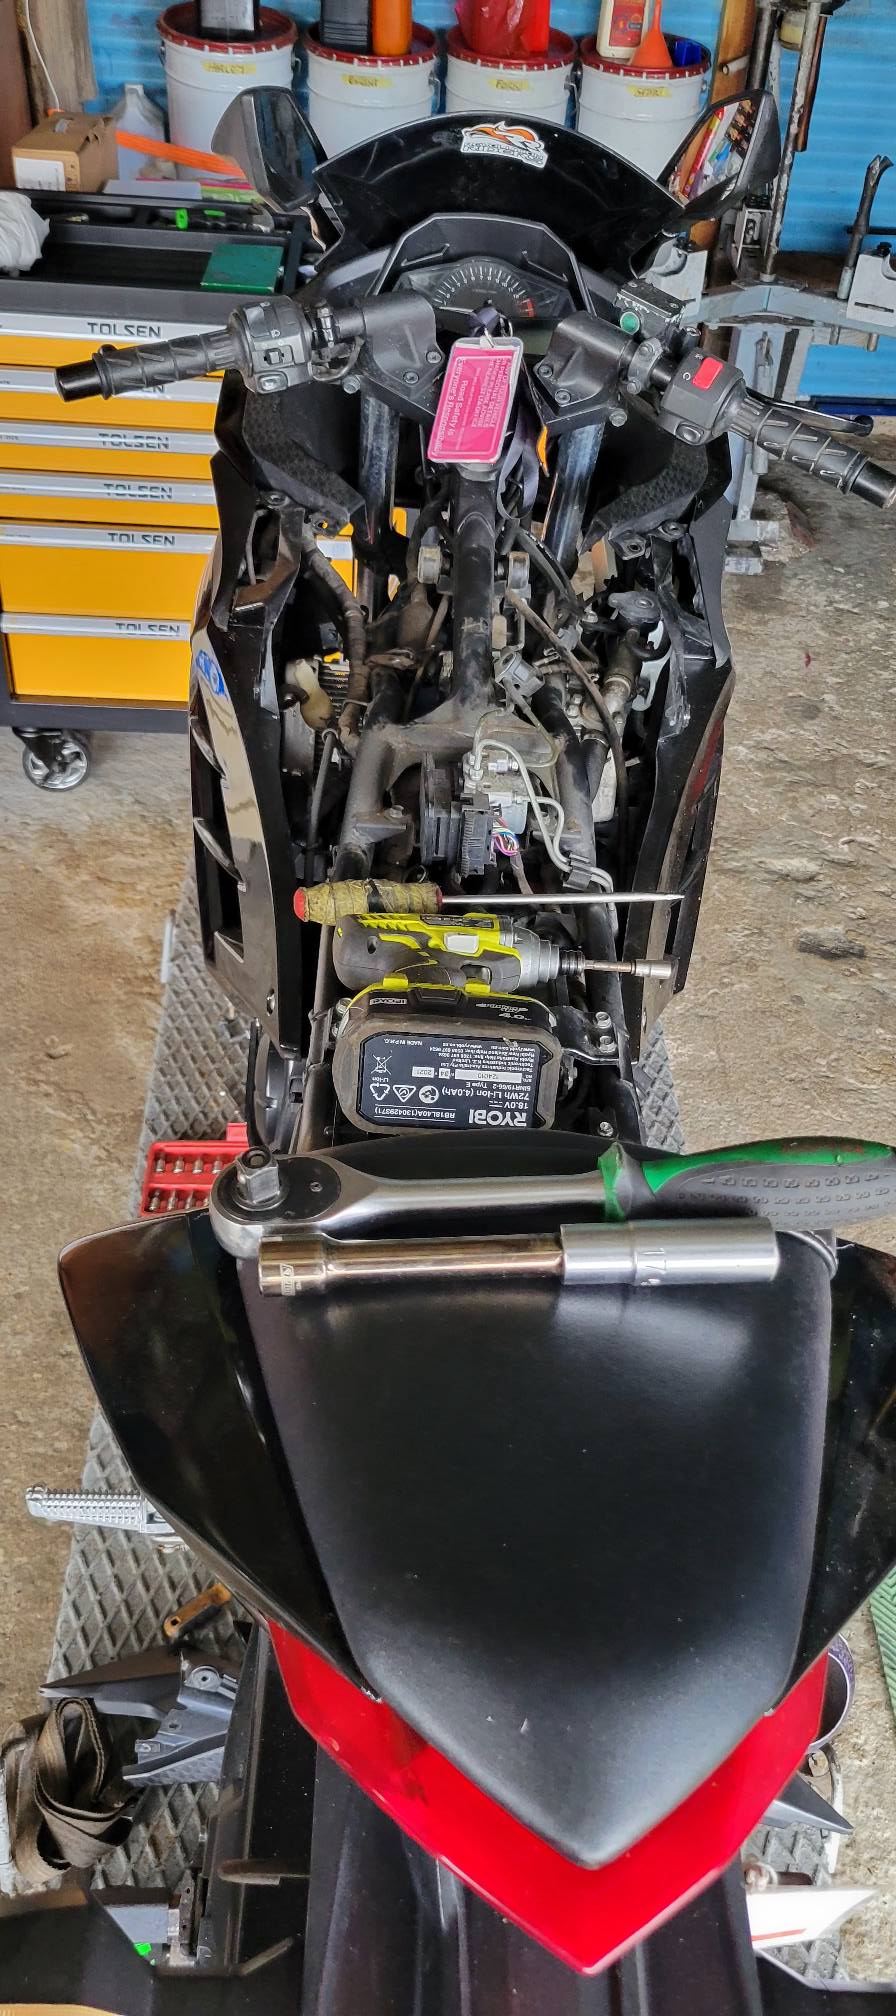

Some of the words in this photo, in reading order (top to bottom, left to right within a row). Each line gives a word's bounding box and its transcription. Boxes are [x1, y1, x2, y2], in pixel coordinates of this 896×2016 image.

[87, 322, 161, 338] TOLSEN
[448, 358, 466, 401] Everyone's
[457, 380, 469, 402] Road
[449, 402, 463, 428] Safety
[99, 433, 169, 449] TOLSEN
[104, 483, 172, 499] TOLSEN
[108, 532, 175, 546] TOLSEN
[115, 622, 180, 636] TOLSEN
[442, 1086, 474, 1096] (4.0Ah)
[504, 1092, 530, 1100] 72Wh
[504, 1101, 529, 1109] 18.0V
[468, 1109, 527, 1127] RYOBI
